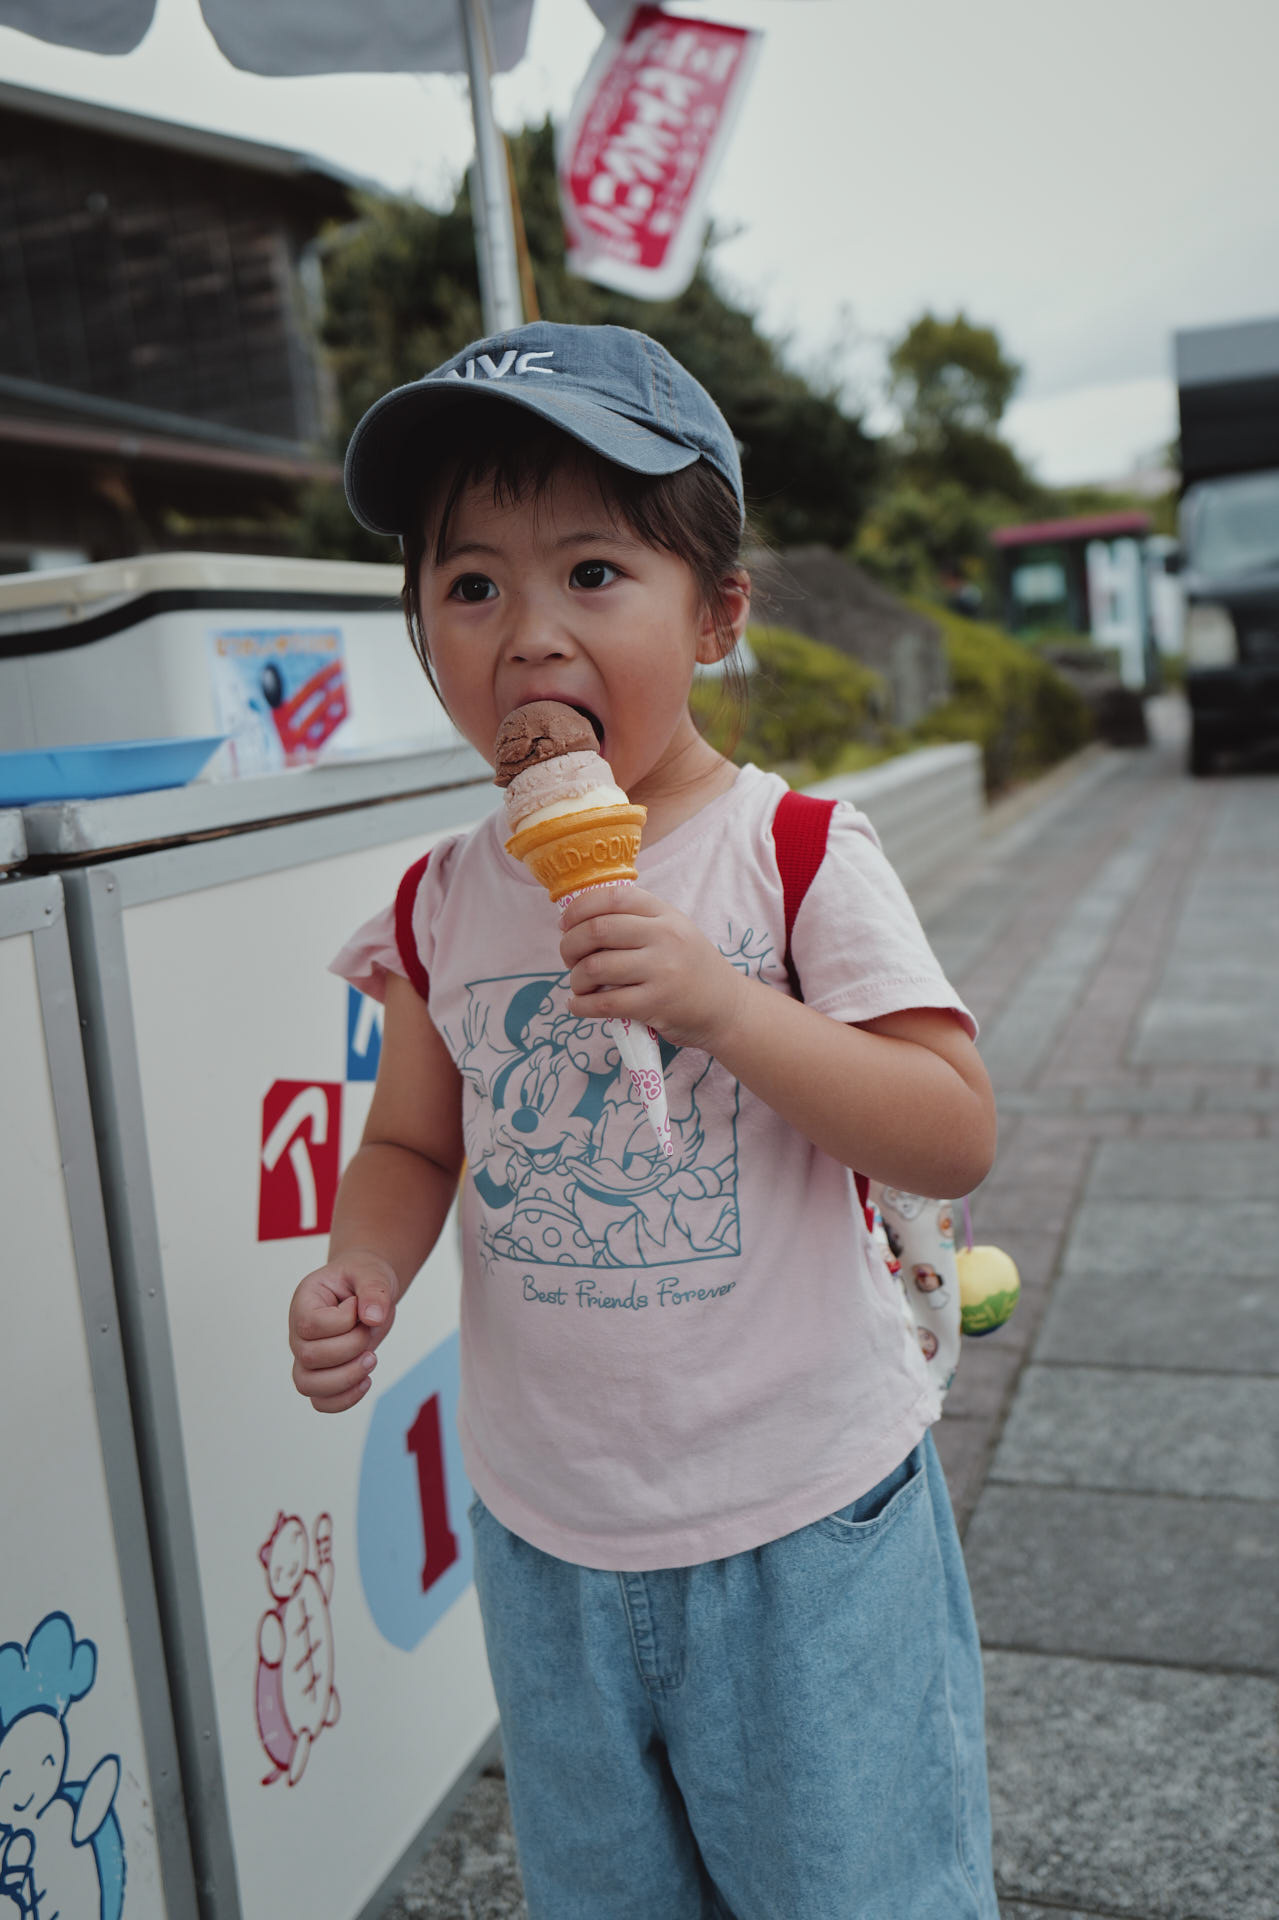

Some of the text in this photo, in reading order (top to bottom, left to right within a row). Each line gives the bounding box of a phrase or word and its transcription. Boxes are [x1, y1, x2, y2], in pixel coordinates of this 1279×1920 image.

[522, 1275, 736, 1310] Best Friends Forever
